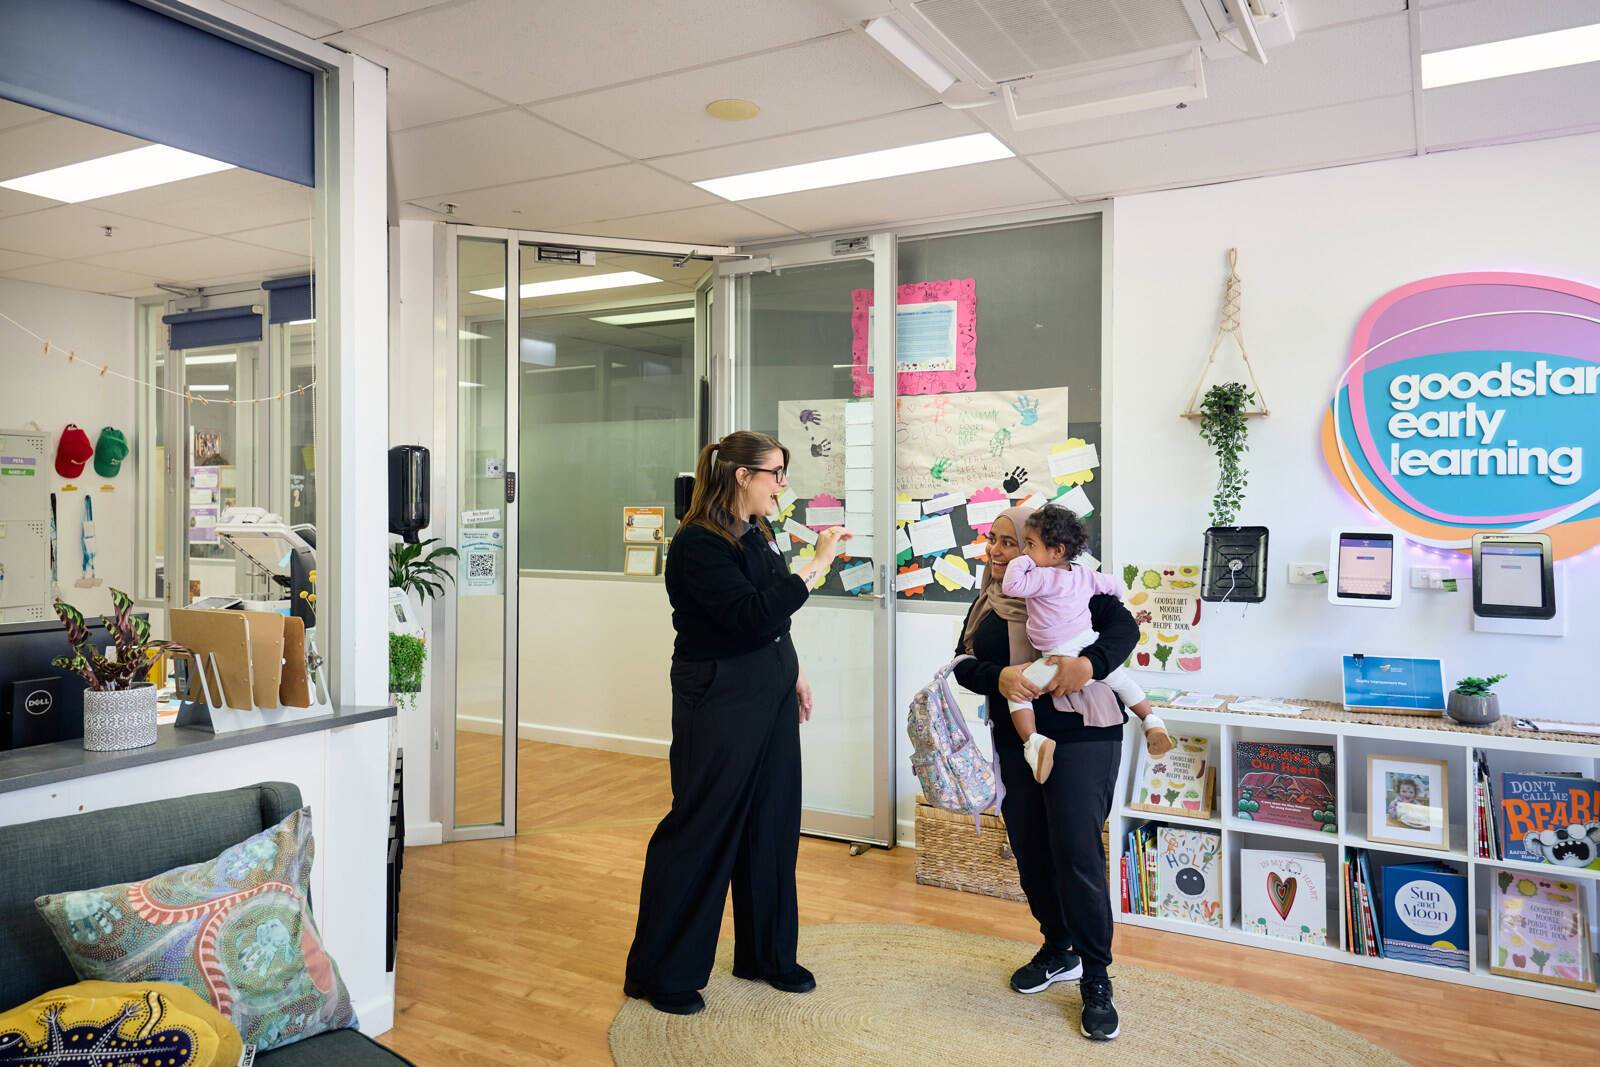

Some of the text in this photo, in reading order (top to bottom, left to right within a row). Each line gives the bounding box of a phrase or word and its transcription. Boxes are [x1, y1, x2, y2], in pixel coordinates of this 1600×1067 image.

[1388, 402, 1506, 445] early
[1391, 440, 1583, 485] learning
[1154, 597, 1188, 606] GOODSTART
[1159, 605, 1183, 613] MOONEE
[1161, 614, 1181, 622] PONDS
[1152, 622, 1190, 631] RECIPE BOOK
[28, 698, 50, 707] DELL
[1259, 745, 1310, 765] Finding
[1251, 757, 1320, 777] Our Heart
[1509, 780, 1556, 794] DON'T
[1522, 793, 1569, 801] CALL ME
[1410, 886, 1440, 902] Sun
[1417, 901, 1435, 909] and
[1403, 903, 1448, 922] Moon
[1528, 927, 1568, 941] RECIPE BOOK
